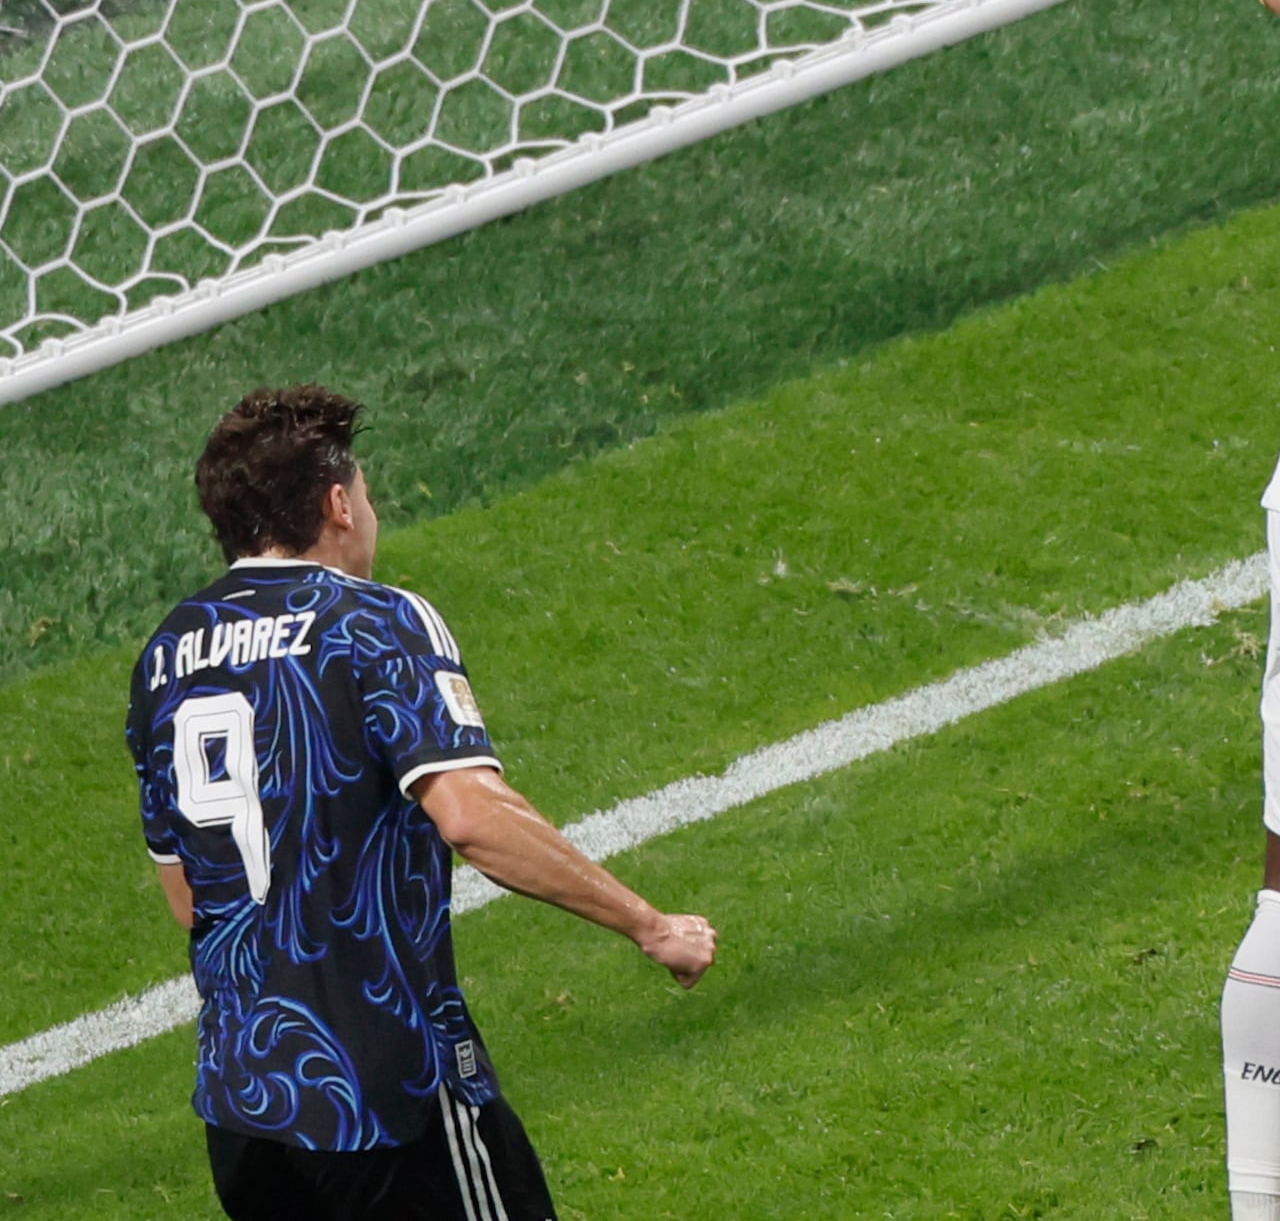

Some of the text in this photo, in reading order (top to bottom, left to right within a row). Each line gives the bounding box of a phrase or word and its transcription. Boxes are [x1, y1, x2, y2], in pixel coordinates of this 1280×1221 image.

[151, 611, 316, 691] J. ALVAREZ
[173, 691, 271, 906] 9
